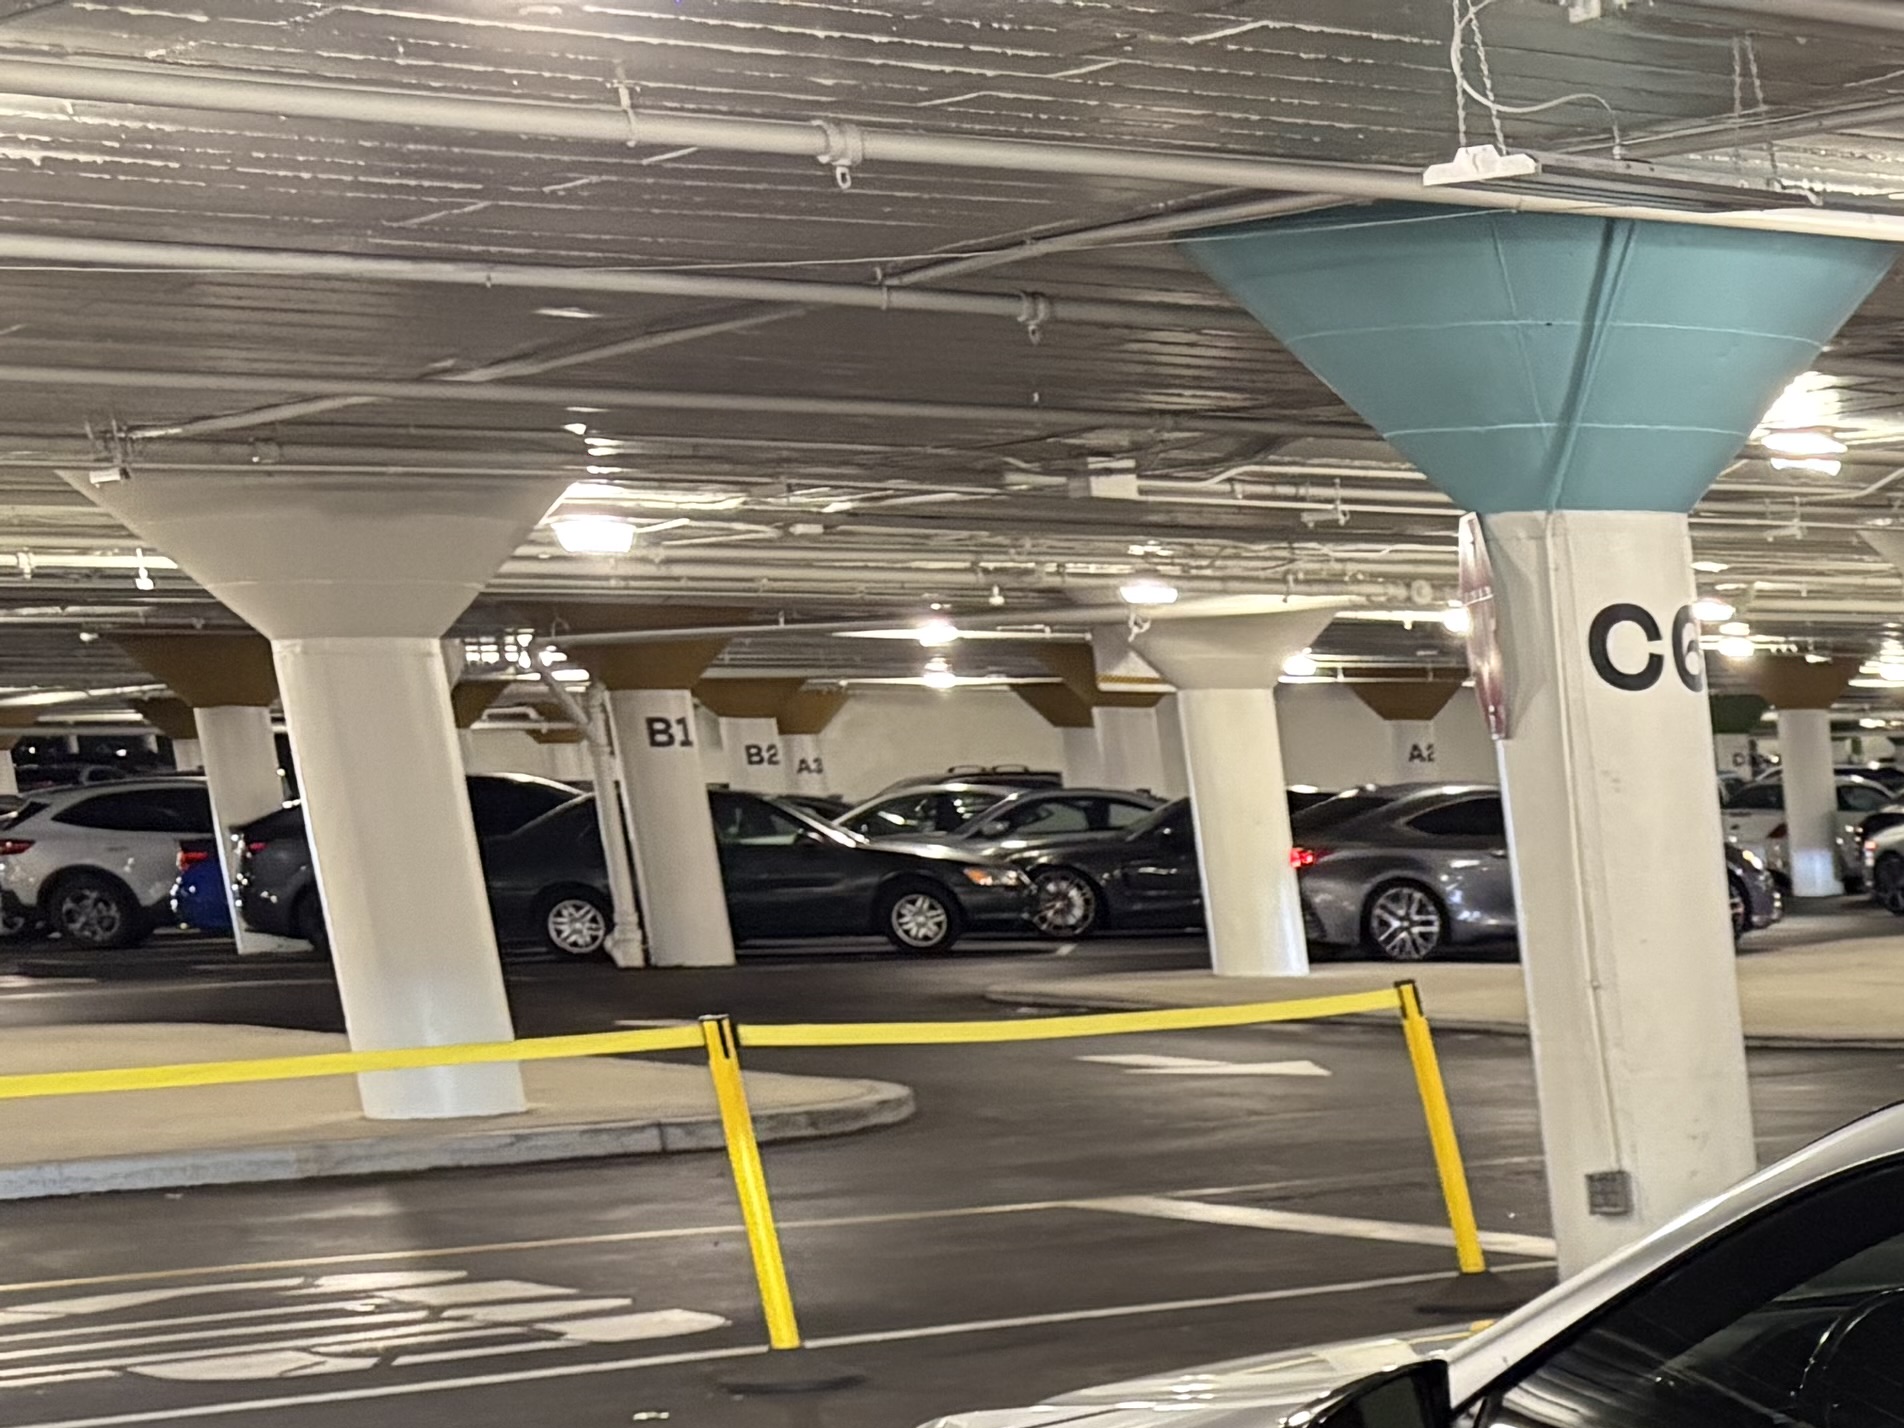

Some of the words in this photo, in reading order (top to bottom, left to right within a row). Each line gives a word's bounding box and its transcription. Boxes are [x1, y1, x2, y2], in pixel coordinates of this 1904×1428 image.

[1588, 602, 1704, 693] C6
[645, 716, 694, 748] B1
[745, 743, 781, 766] B2
